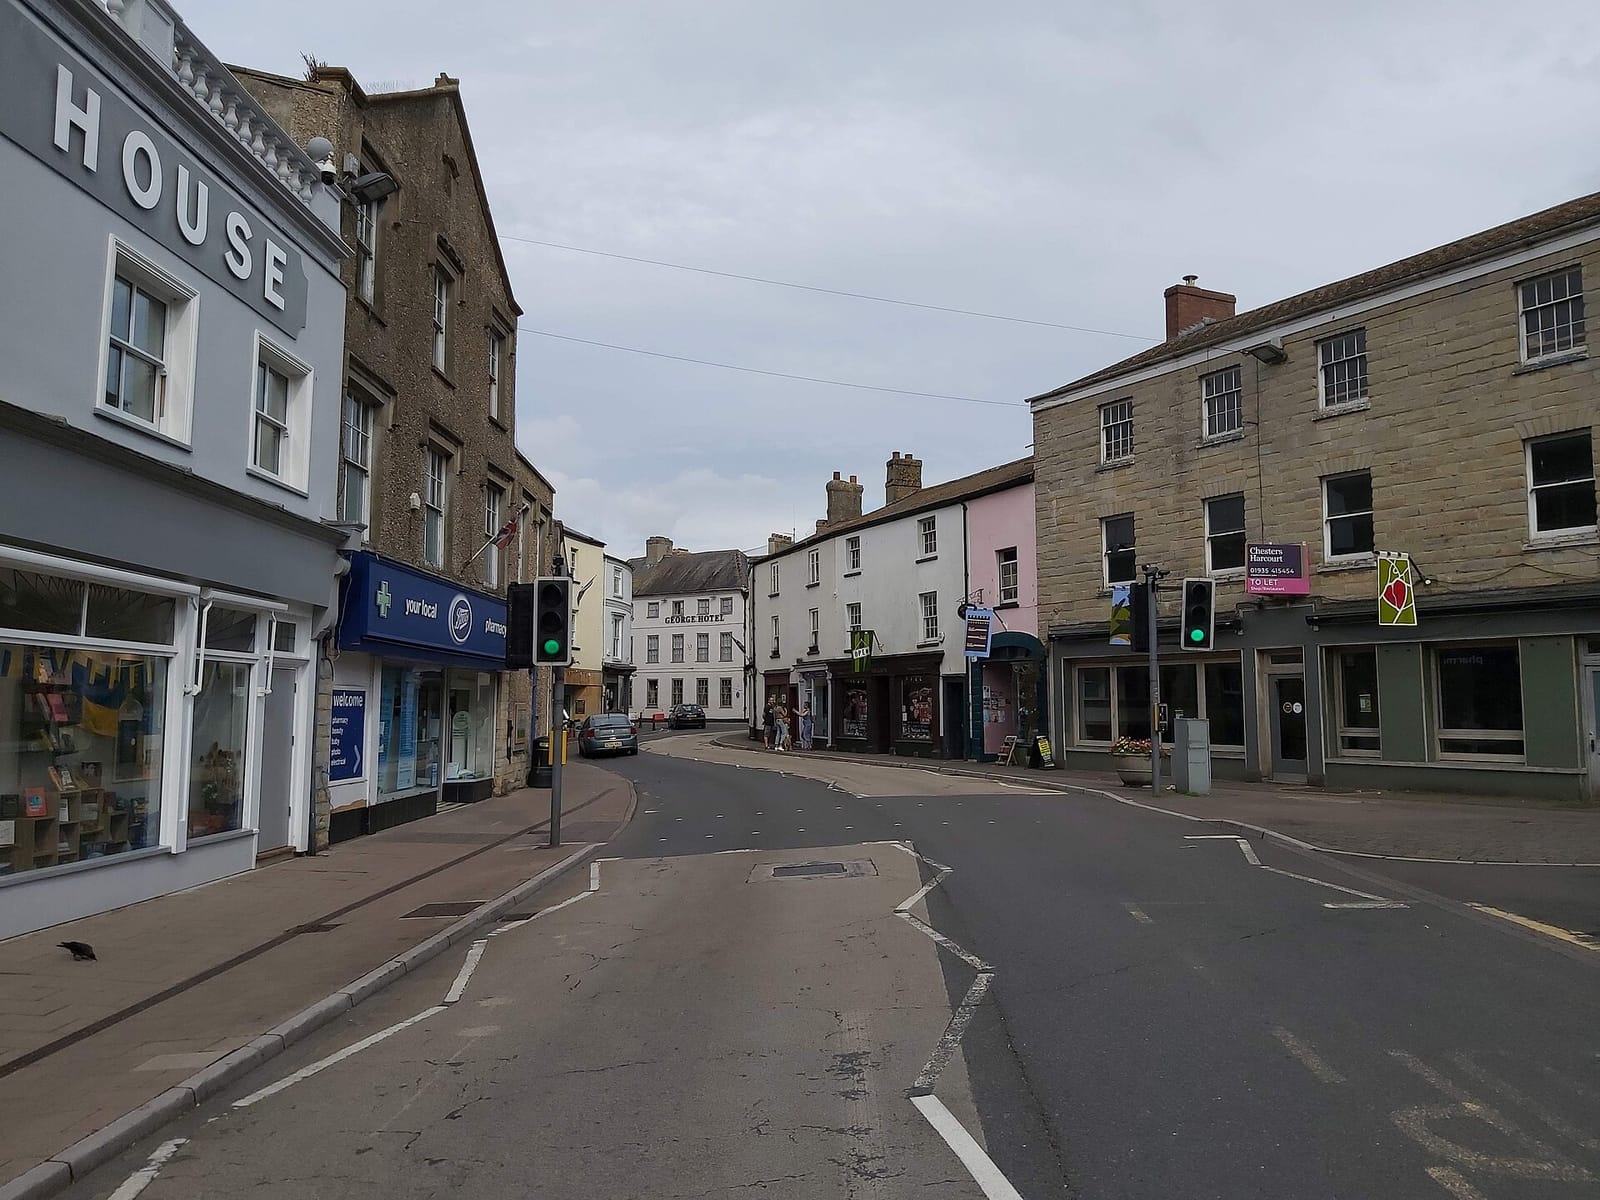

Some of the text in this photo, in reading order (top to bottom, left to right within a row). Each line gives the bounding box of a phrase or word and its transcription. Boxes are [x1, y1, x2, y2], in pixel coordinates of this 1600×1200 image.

[54, 63, 287, 312] HOUSE
[1250, 546, 1283, 555] Chesters
[405, 598, 438, 619] your local
[454, 607, 469, 630] Boots
[484, 618, 507, 638] pharmacy
[664, 614, 725, 624] GEORGE HOTEL
[333, 691, 363, 707] welcome
